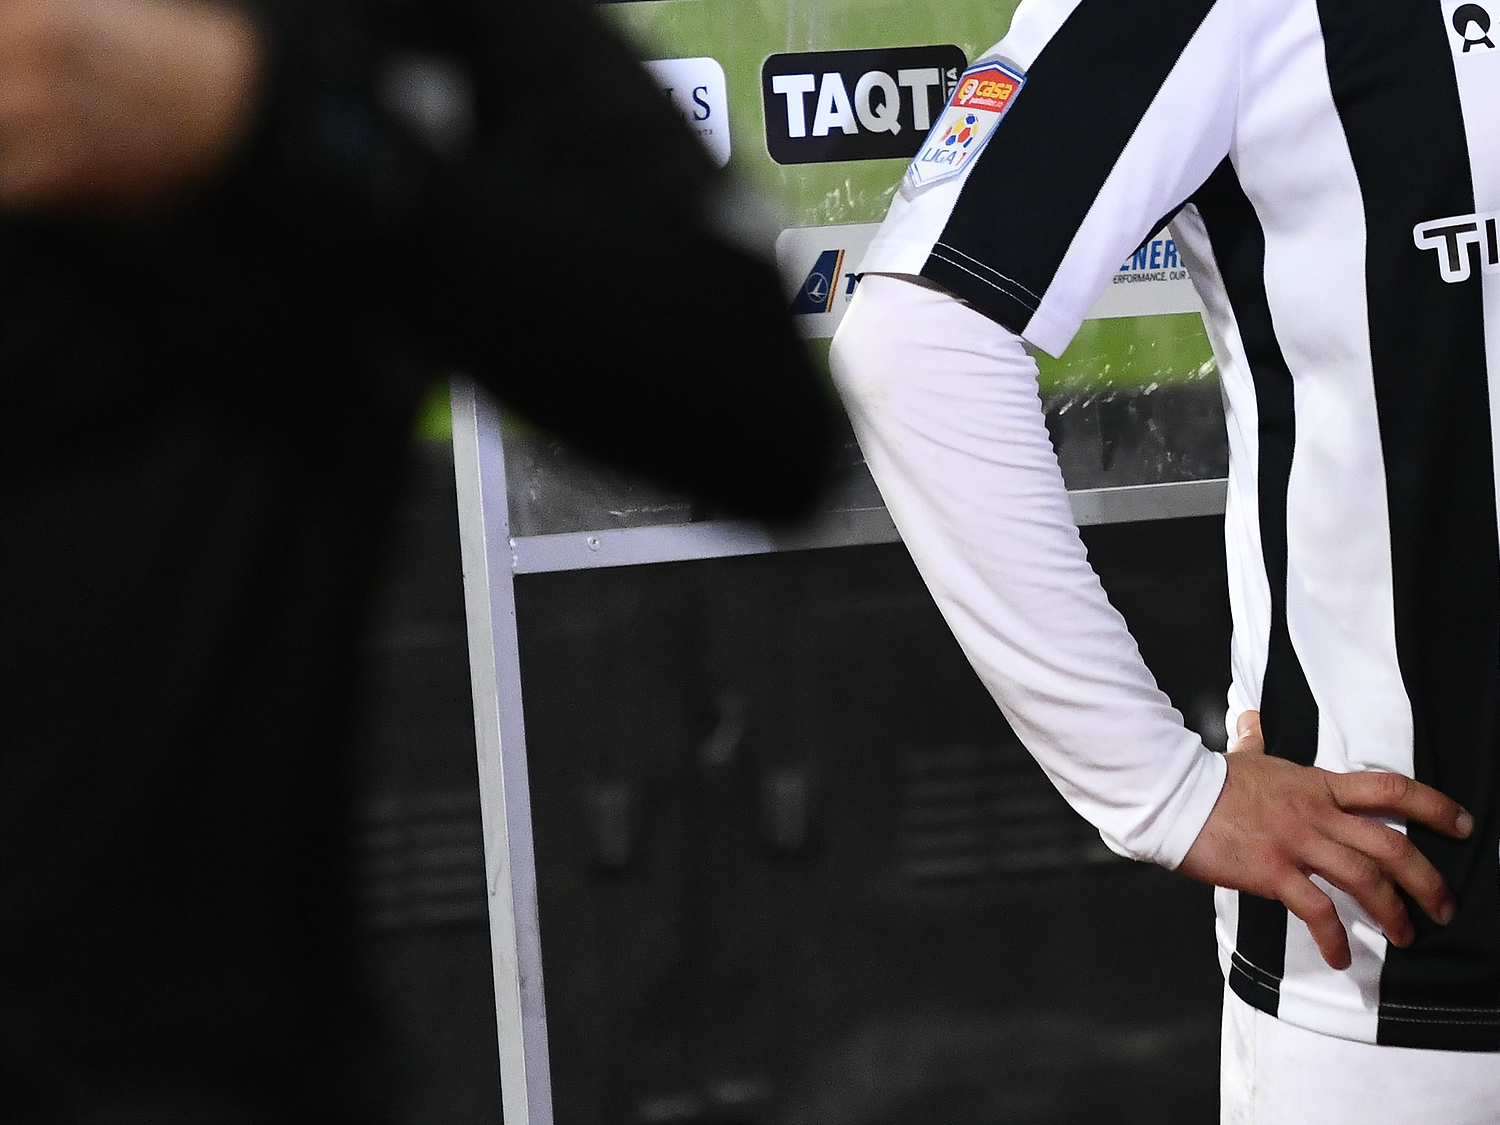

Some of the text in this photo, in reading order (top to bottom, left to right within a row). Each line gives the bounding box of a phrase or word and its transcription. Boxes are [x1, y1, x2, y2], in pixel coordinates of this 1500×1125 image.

[975, 80, 1013, 101] casa
[772, 67, 940, 138] TAQT
[921, 147, 967, 166] LIGA 1
